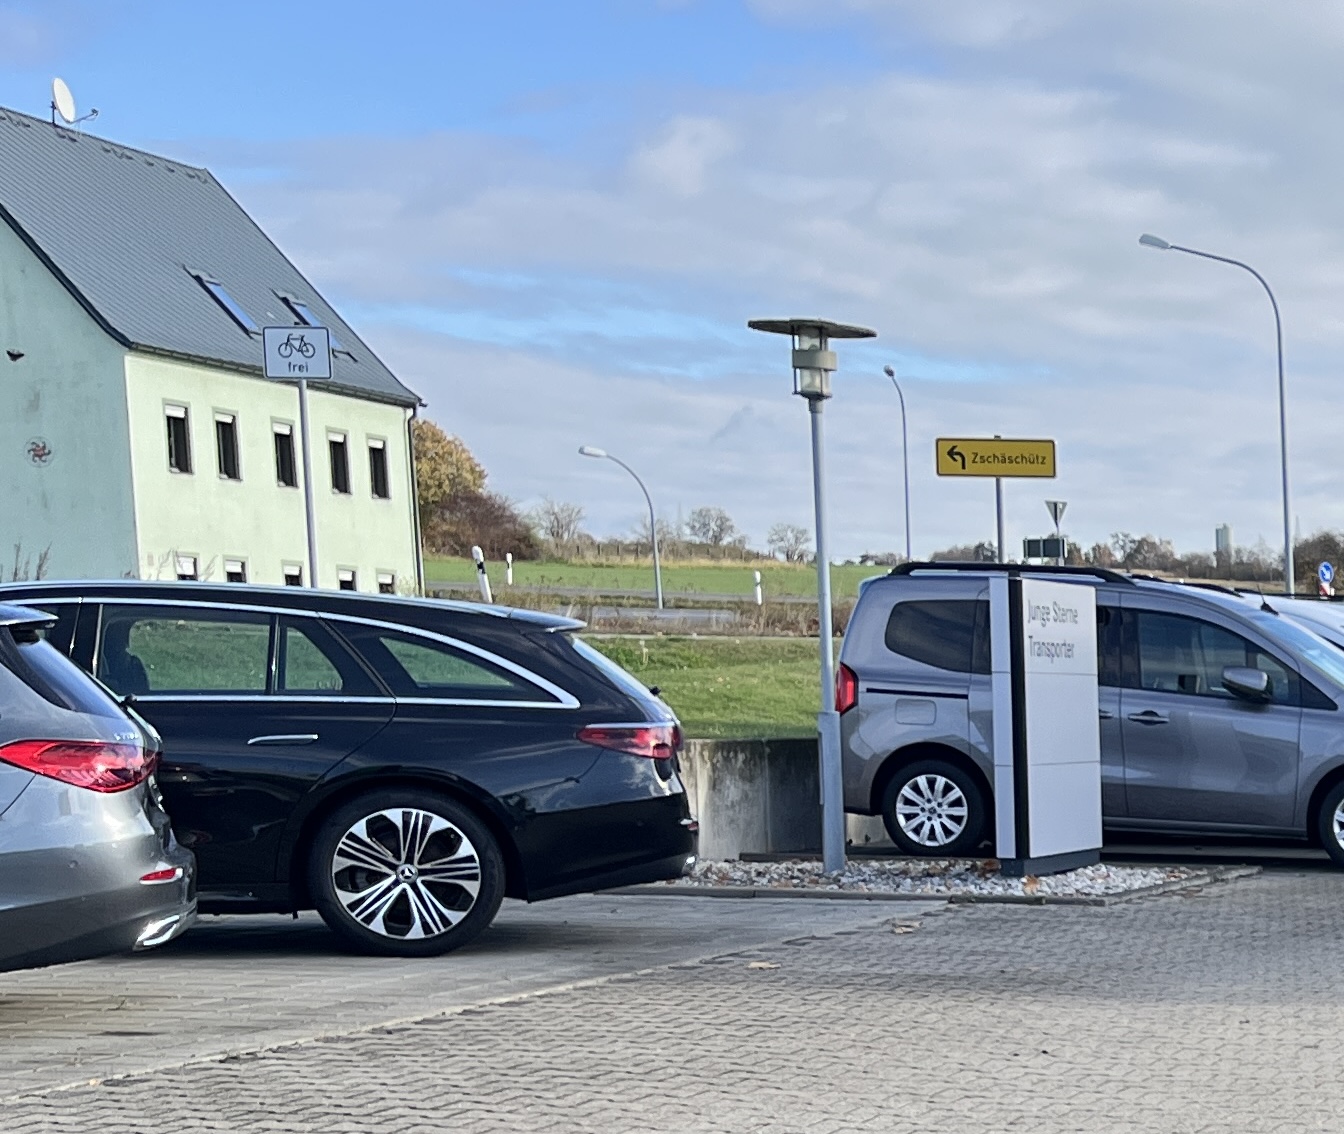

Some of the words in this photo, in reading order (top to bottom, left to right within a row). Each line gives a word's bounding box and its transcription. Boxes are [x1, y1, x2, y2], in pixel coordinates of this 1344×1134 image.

[288, 361, 309, 373] frei
[971, 451, 1047, 465] Zschäschütz
[1027, 599, 1050, 628] Junge
[1052, 600, 1079, 624] Sterne
[1028, 635, 1075, 664] Transporter
